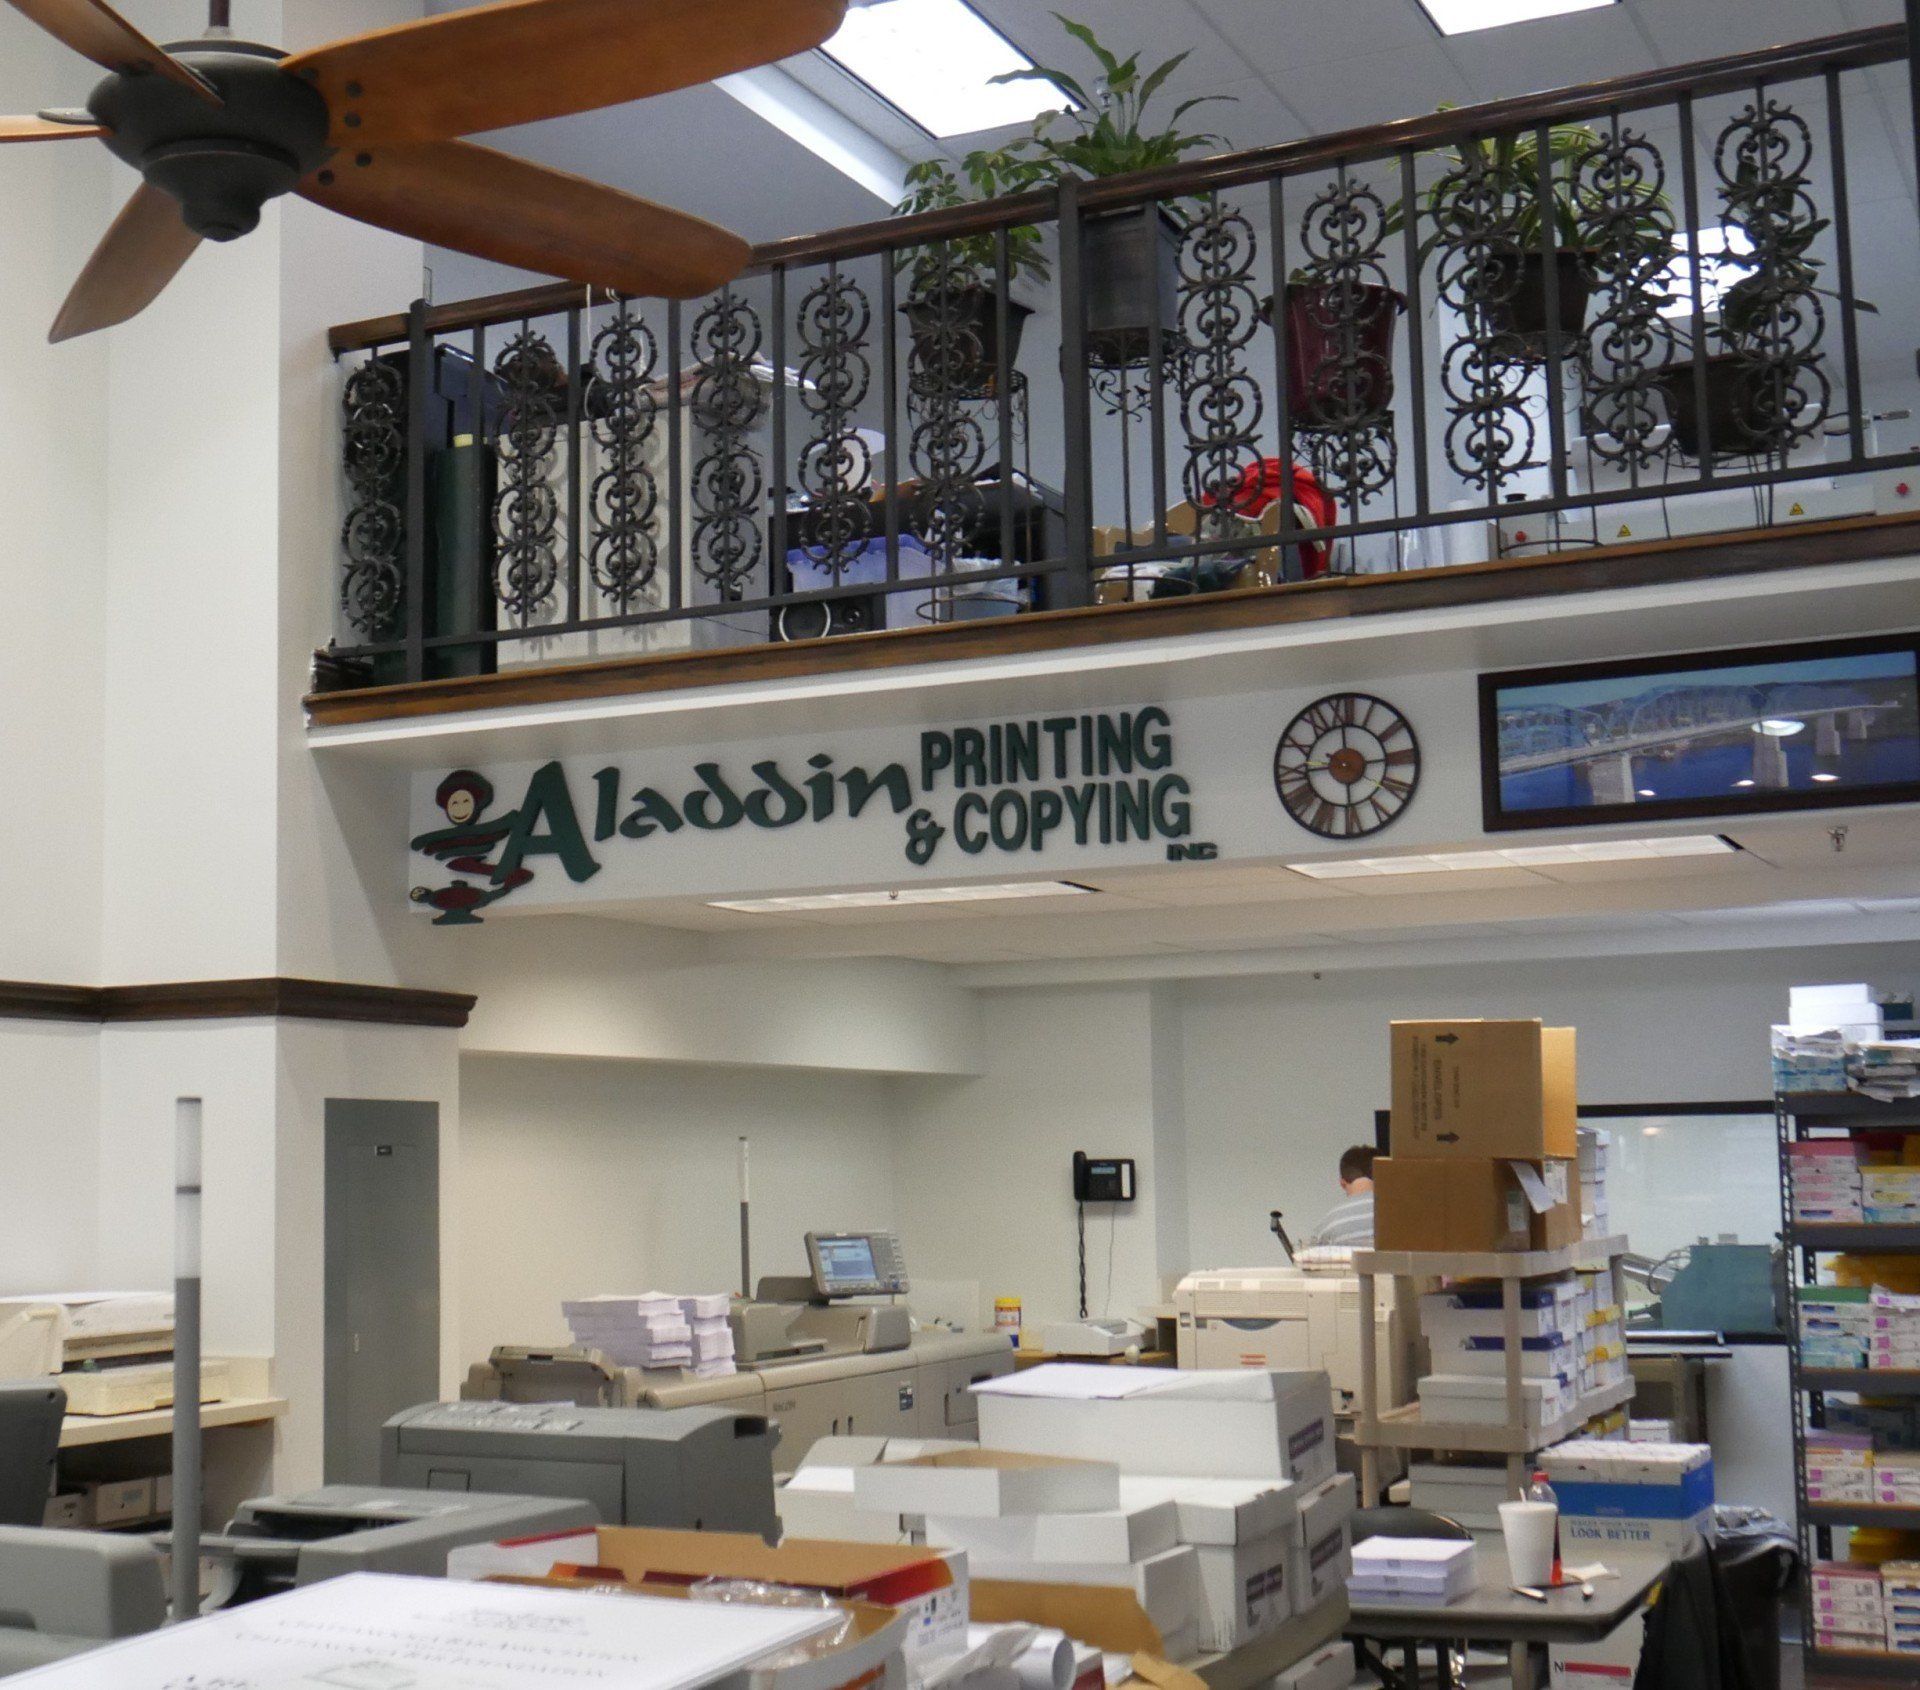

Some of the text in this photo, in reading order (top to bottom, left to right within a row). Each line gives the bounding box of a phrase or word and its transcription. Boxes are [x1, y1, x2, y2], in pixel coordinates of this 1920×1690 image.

[921, 706, 1172, 792] PRINTING
[490, 754, 912, 883] Aladdin
[905, 773, 1191, 866] & COPYING
[1166, 842, 1218, 861] INC
[1570, 1527, 1650, 1540] LOOK BETTER
